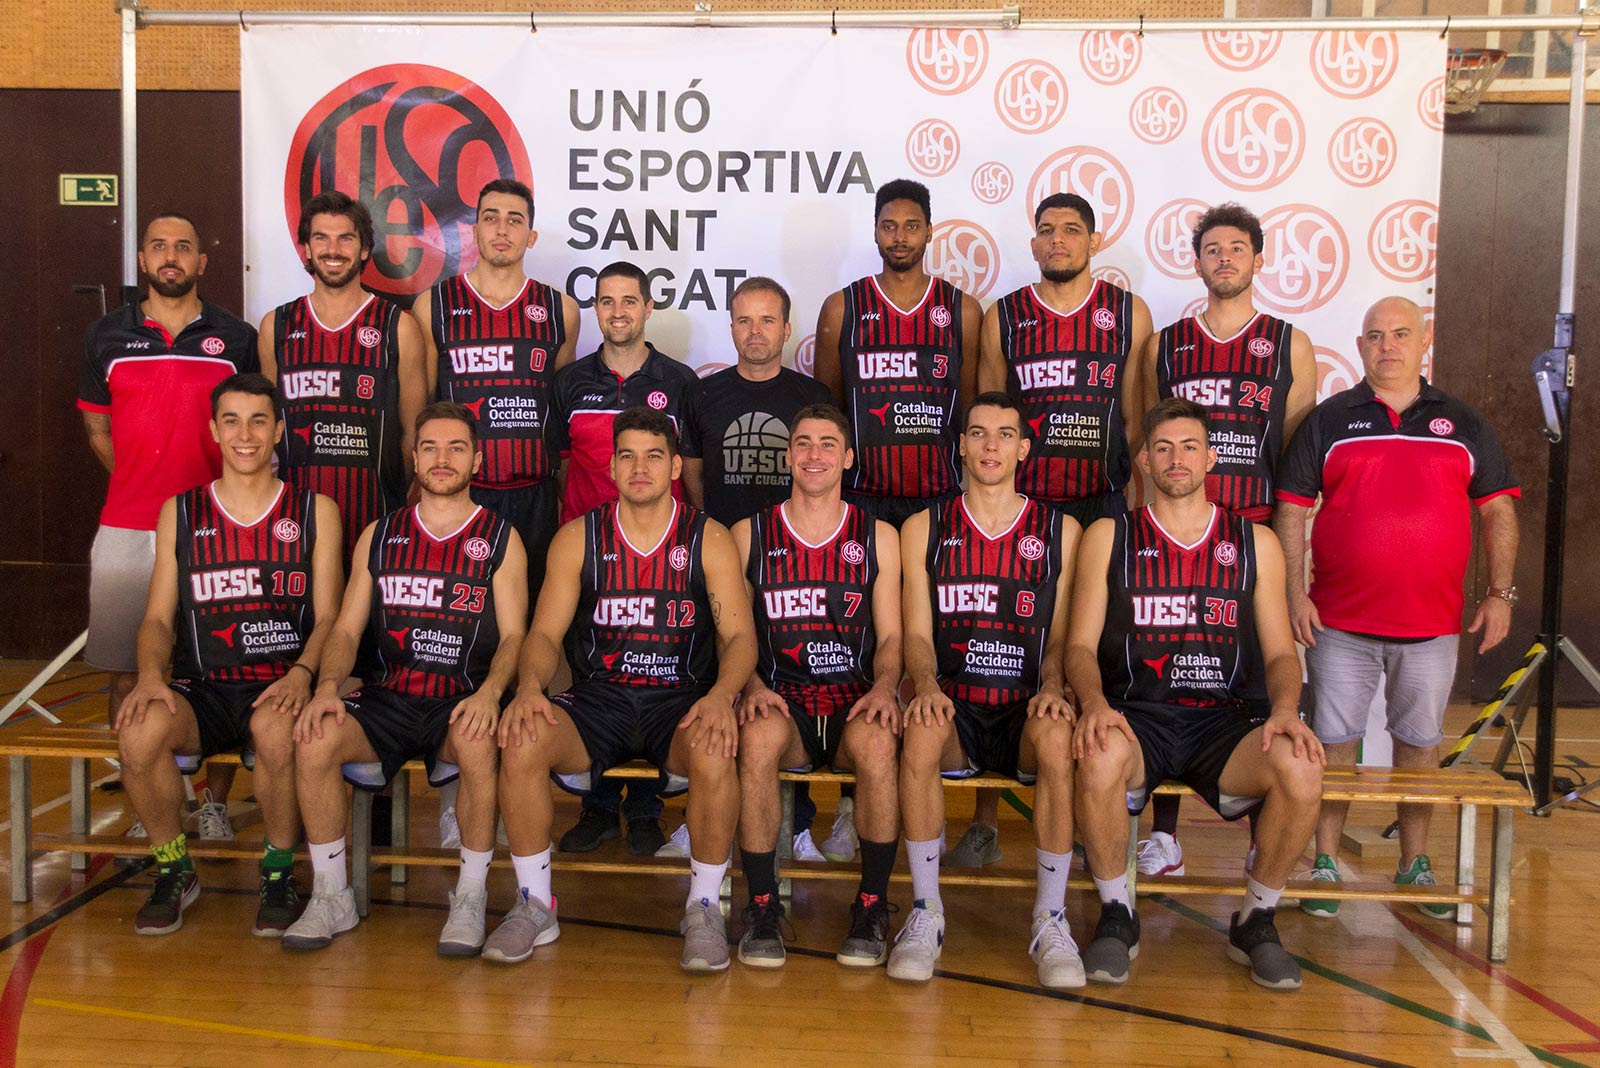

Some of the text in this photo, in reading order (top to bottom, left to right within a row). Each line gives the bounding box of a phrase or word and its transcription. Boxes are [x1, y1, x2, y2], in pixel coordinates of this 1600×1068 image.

[569, 79, 711, 134] UNIÓ
[568, 148, 876, 194] ESPORTIVA
[567, 208, 717, 252] SANT
[565, 266, 747, 311] CGAT
[449, 344, 547, 375] UESC 0
[857, 352, 949, 379] UESC 3
[1016, 359, 1117, 391] UESC 14
[283, 370, 375, 400] UESC 8
[488, 396, 537, 408] Catalan
[1170, 378, 1273, 411] UESC 24
[489, 408, 538, 420] Occiden
[1049, 412, 1100, 426] Catalana
[314, 422, 367, 436] Catalana
[895, 427, 941, 435] Asseguraes
[1047, 425, 1101, 439] Occident
[314, 434, 369, 449] Occident
[1208, 431, 1257, 445] atalana
[314, 446, 369, 456] Assegurances
[1209, 443, 1257, 458] cident
[1215, 456, 1255, 465] gurances
[724, 474, 791, 486] SANT CUGAT
[191, 568, 307, 602] UESC 10
[378, 575, 488, 613] UESC 23
[937, 584, 1036, 618] UESC 6
[764, 588, 863, 619] UESC 7
[1133, 594, 1238, 627] UESC 30
[593, 597, 696, 628] UESC 12
[241, 620, 294, 634] Catalan
[412, 628, 463, 645] Catalana
[412, 641, 461, 657] Occident
[968, 638, 1025, 657] Catalana
[623, 651, 680, 665] Catalana
[965, 652, 1023, 669] Occident
[1173, 653, 1221, 668] Catalan
[965, 665, 1022, 677] Assegurances
[1171, 667, 1224, 681] Occiden
